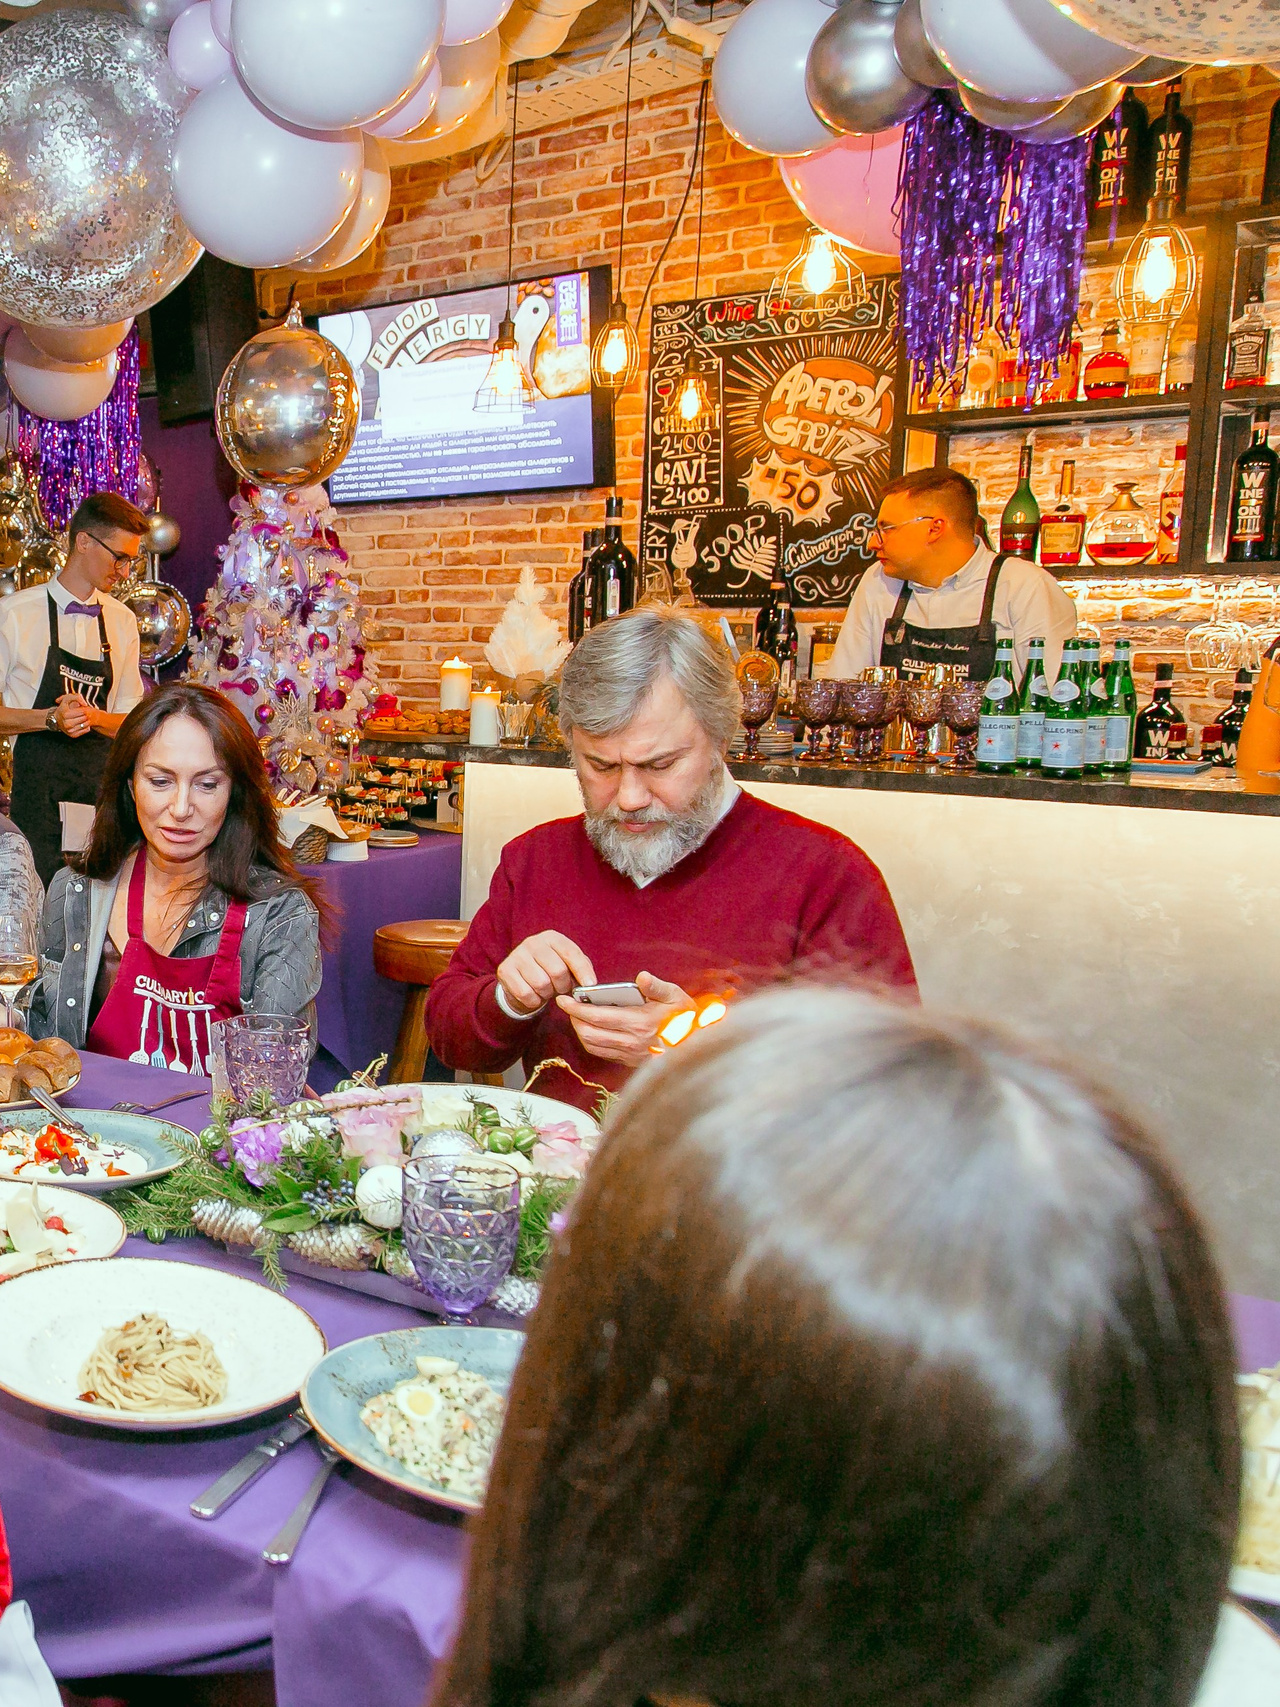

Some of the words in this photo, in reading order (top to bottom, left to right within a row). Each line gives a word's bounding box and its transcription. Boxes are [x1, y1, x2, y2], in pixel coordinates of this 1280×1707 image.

[706, 301, 755, 324] Wine
[372, 302, 432, 365] FOOD
[397, 318, 485, 366] ERGY
[771, 361, 893, 429] APEROL
[661, 432, 712, 459] 2400
[761, 467, 820, 511] 450
[1242, 472, 1265, 488] W
[661, 486, 710, 507] 2400
[1239, 488, 1263, 499] INE
[1238, 506, 1260, 516] ON
[1148, 729, 1170, 747] W
